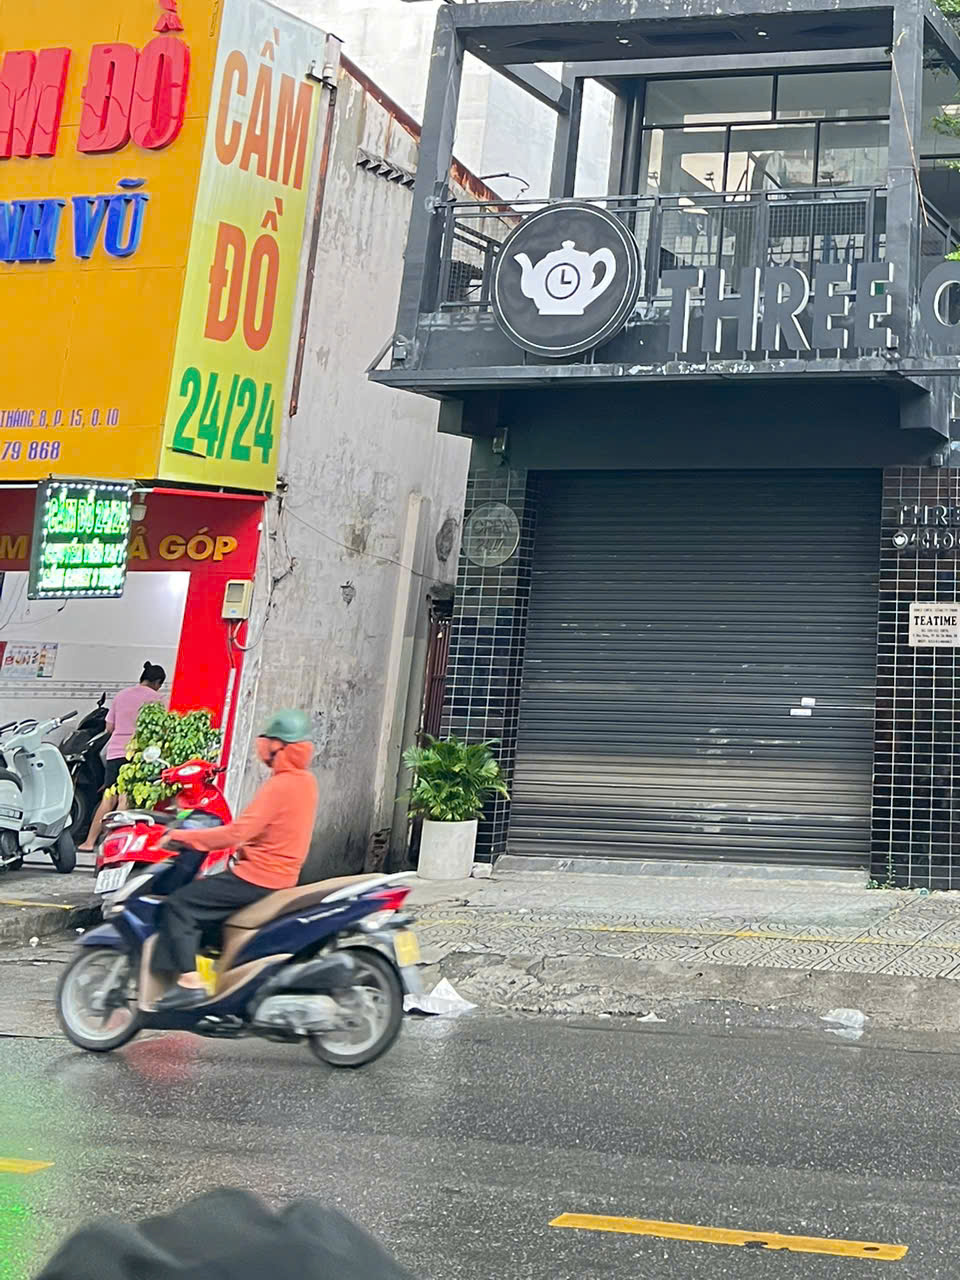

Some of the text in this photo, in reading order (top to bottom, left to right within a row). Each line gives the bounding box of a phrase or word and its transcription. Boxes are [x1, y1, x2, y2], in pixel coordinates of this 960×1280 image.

[213, 28, 313, 190] CẦM
[72, 178, 149, 259] VŨ
[204, 197, 283, 351] ĐỒ
[661, 261, 893, 353] THREE
[27, 441, 61, 460] 868
[172, 366, 274, 464] 24/24
[159, 527, 238, 561] GÓP
[914, 615, 958, 626] TEATIME
